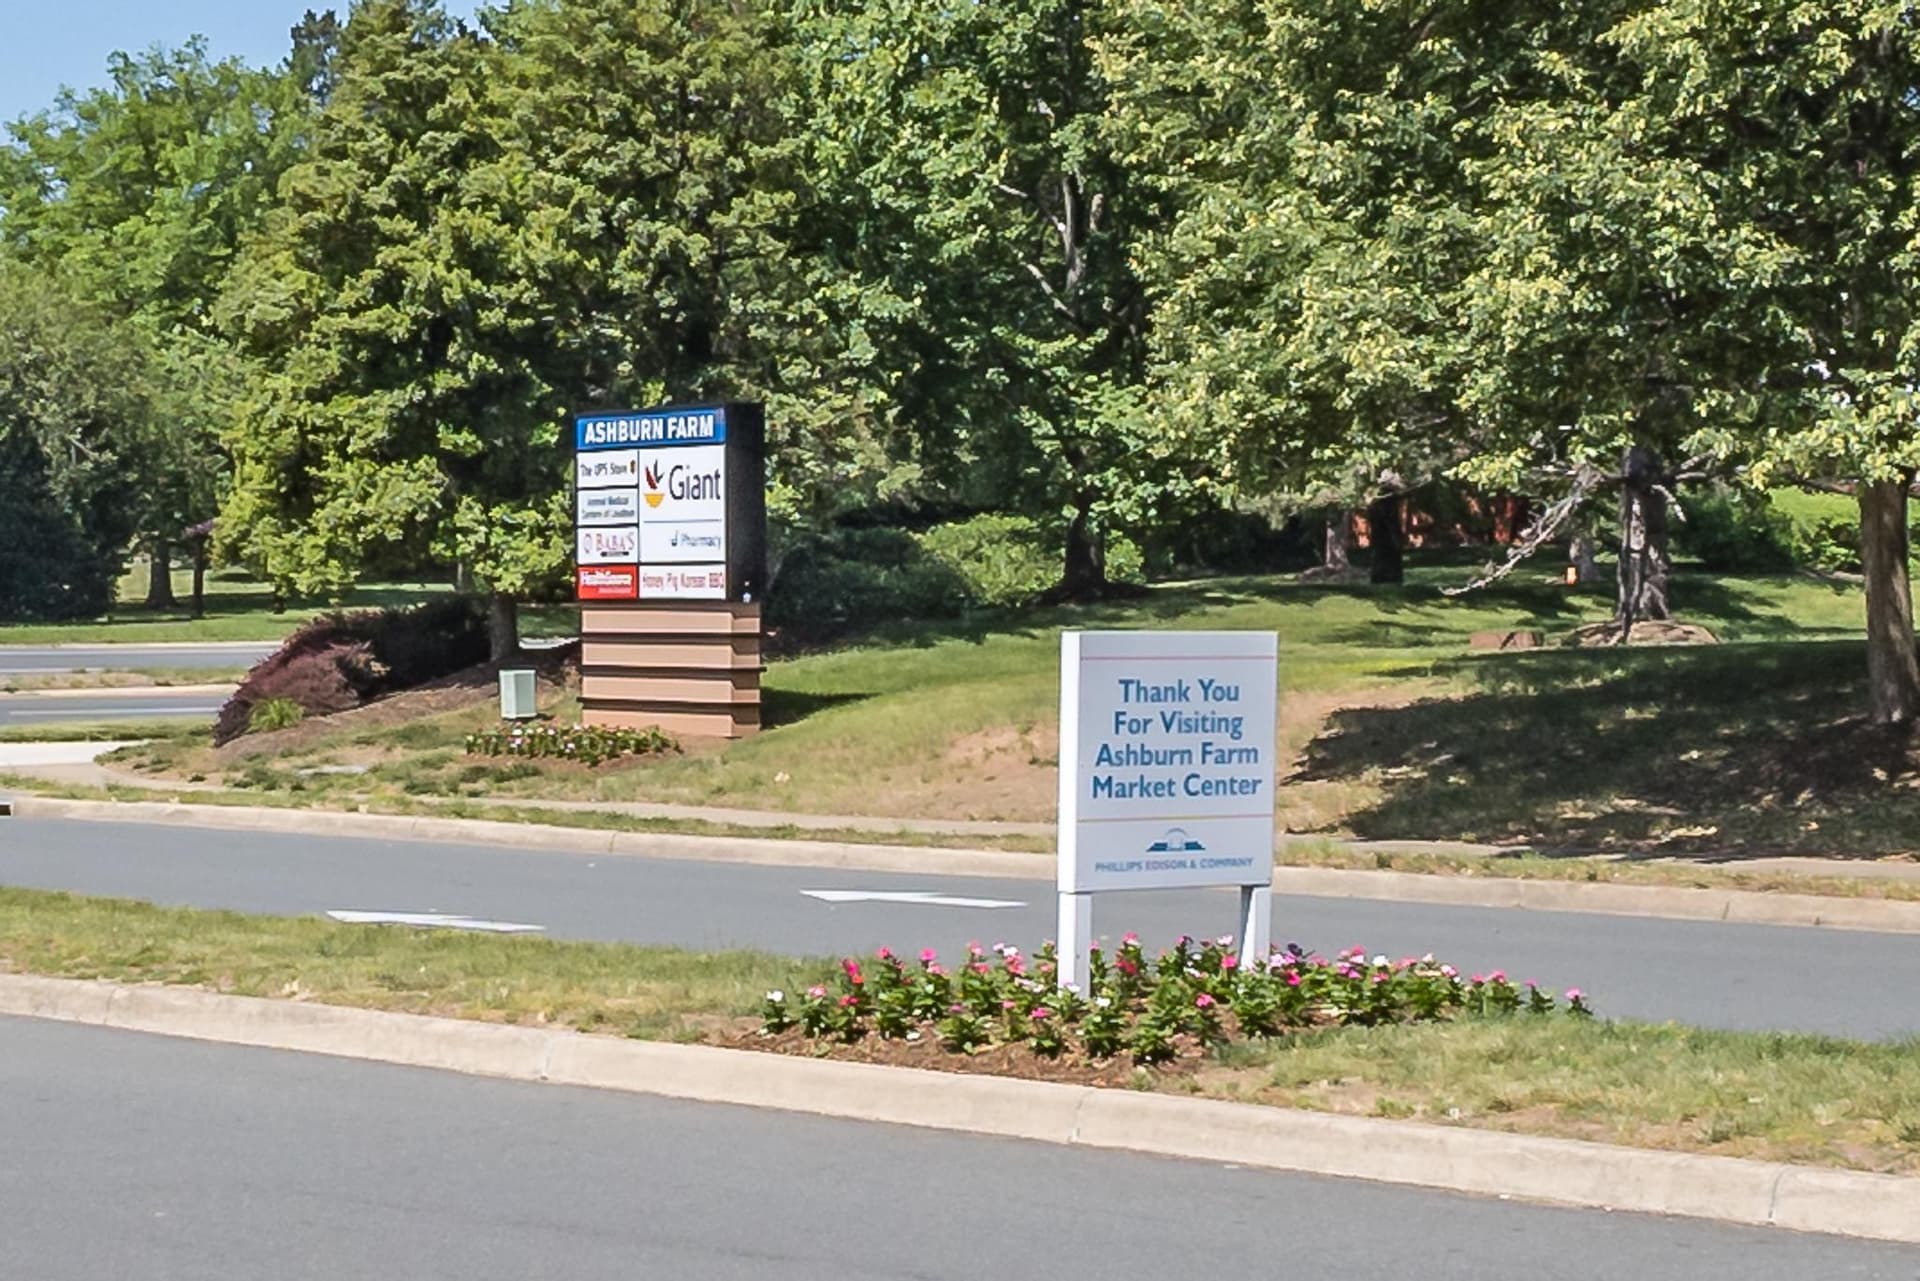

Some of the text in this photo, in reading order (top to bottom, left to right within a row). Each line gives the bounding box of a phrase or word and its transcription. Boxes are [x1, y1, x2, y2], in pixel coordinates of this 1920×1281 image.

[585, 415, 714, 444] ASHBURN FARM
[669, 465, 721, 500] Giant
[1118, 678, 1240, 703] Thank You
[1114, 710, 1244, 740] For Visiting
[1095, 741, 1259, 767] Ashburn Farm
[1092, 773, 1263, 799] Market Center
[1095, 857, 1255, 872] PHILLIPS EDISON & COMPANY
